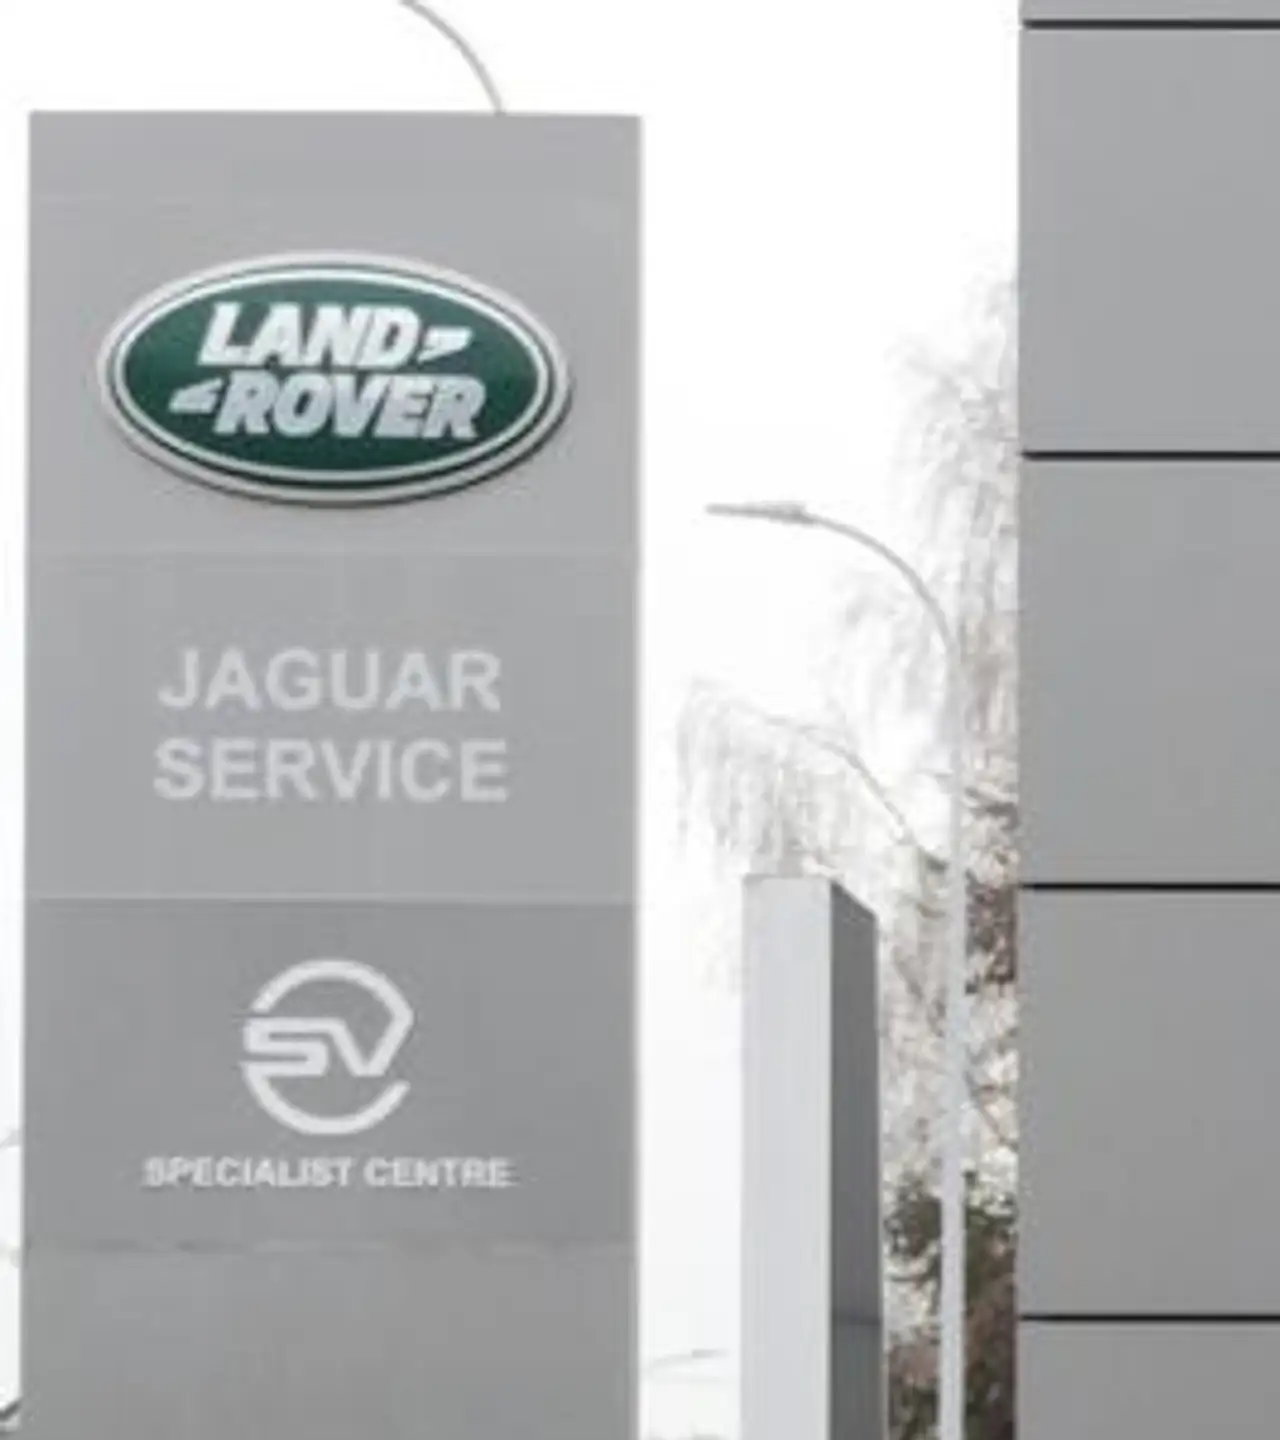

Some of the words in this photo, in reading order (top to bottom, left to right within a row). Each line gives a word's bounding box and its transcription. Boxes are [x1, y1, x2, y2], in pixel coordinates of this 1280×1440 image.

[197, 301, 421, 367] LAND
[213, 370, 487, 439] ROVER
[156, 646, 503, 713] JAGUAR
[152, 736, 510, 804] SERVICE
[144, 1156, 352, 1189] SPECIALIST
[362, 1156, 514, 1189] CENTRE
